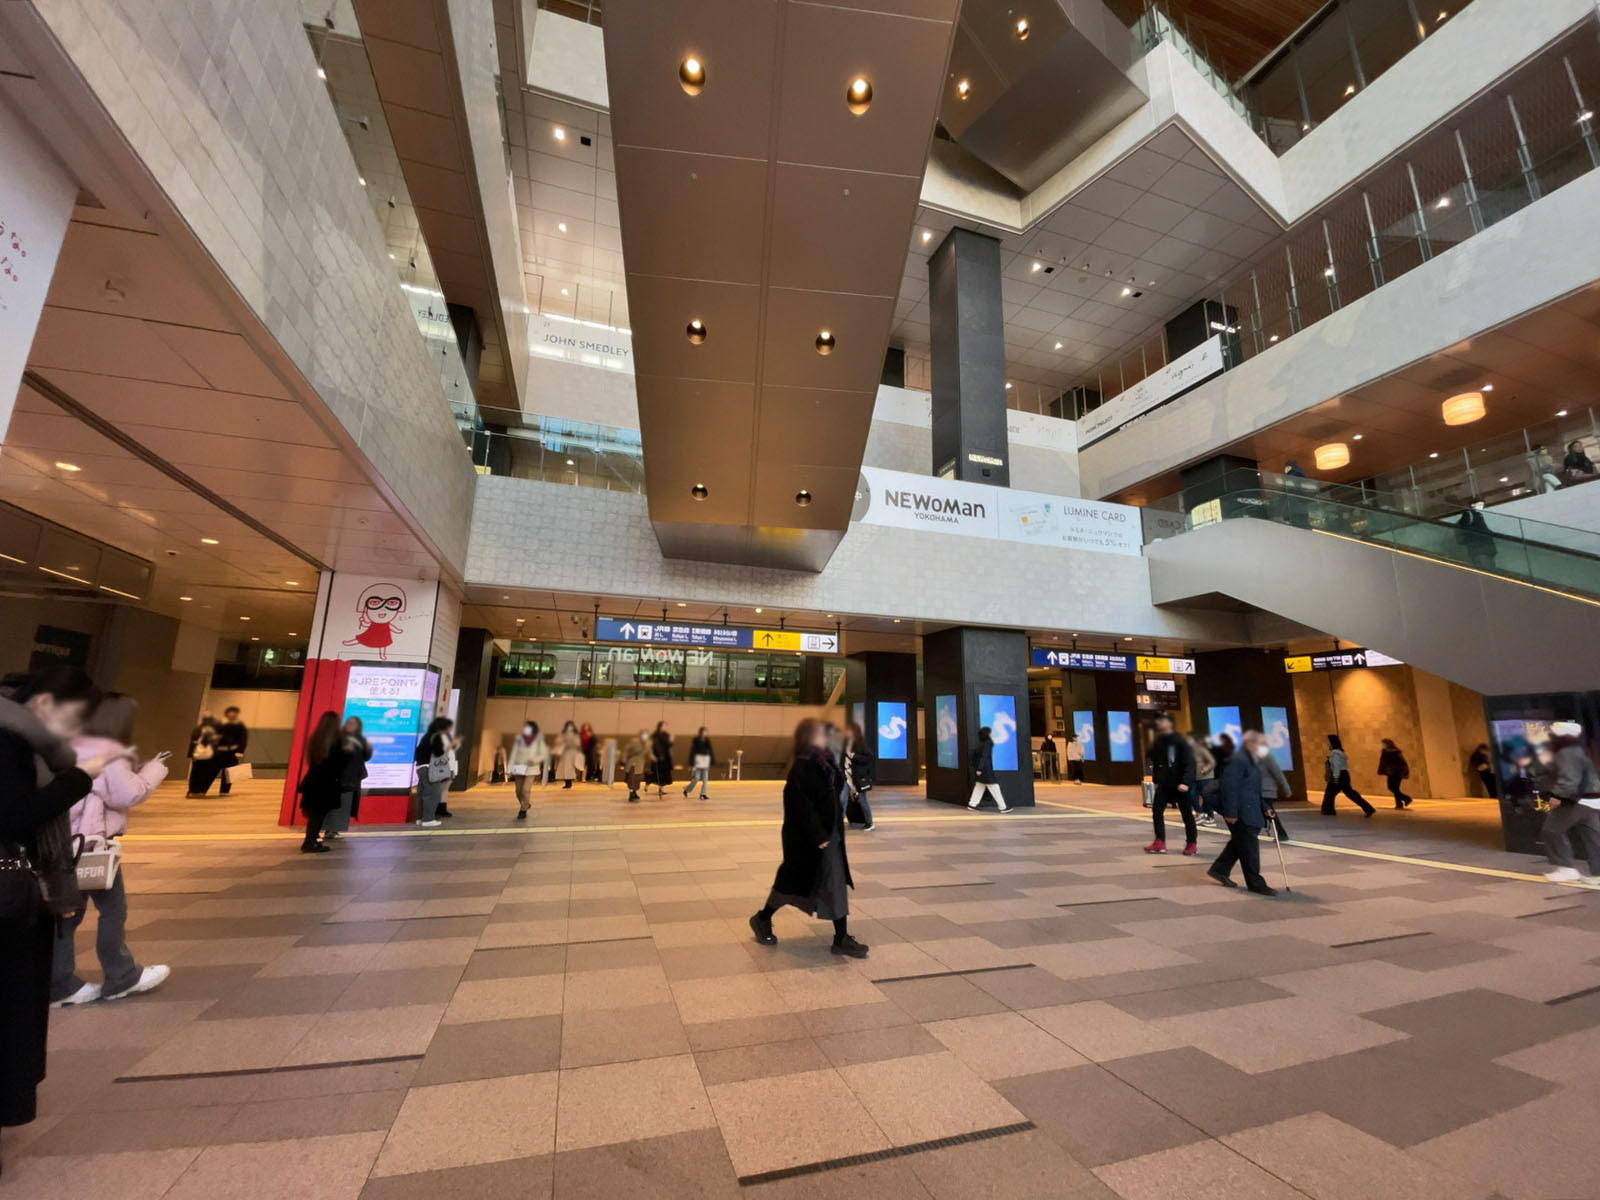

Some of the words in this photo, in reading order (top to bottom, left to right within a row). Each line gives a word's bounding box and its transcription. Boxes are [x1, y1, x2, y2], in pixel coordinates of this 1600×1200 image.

[543, 334, 576, 348] JOHN
[579, 340, 629, 357] SMEDLEY
[885, 489, 985, 519] NEWoMan
[1063, 505, 1099, 520] LUMINE
[1101, 511, 1127, 523] CARD
[914, 511, 959, 524] YOKOHAMA
